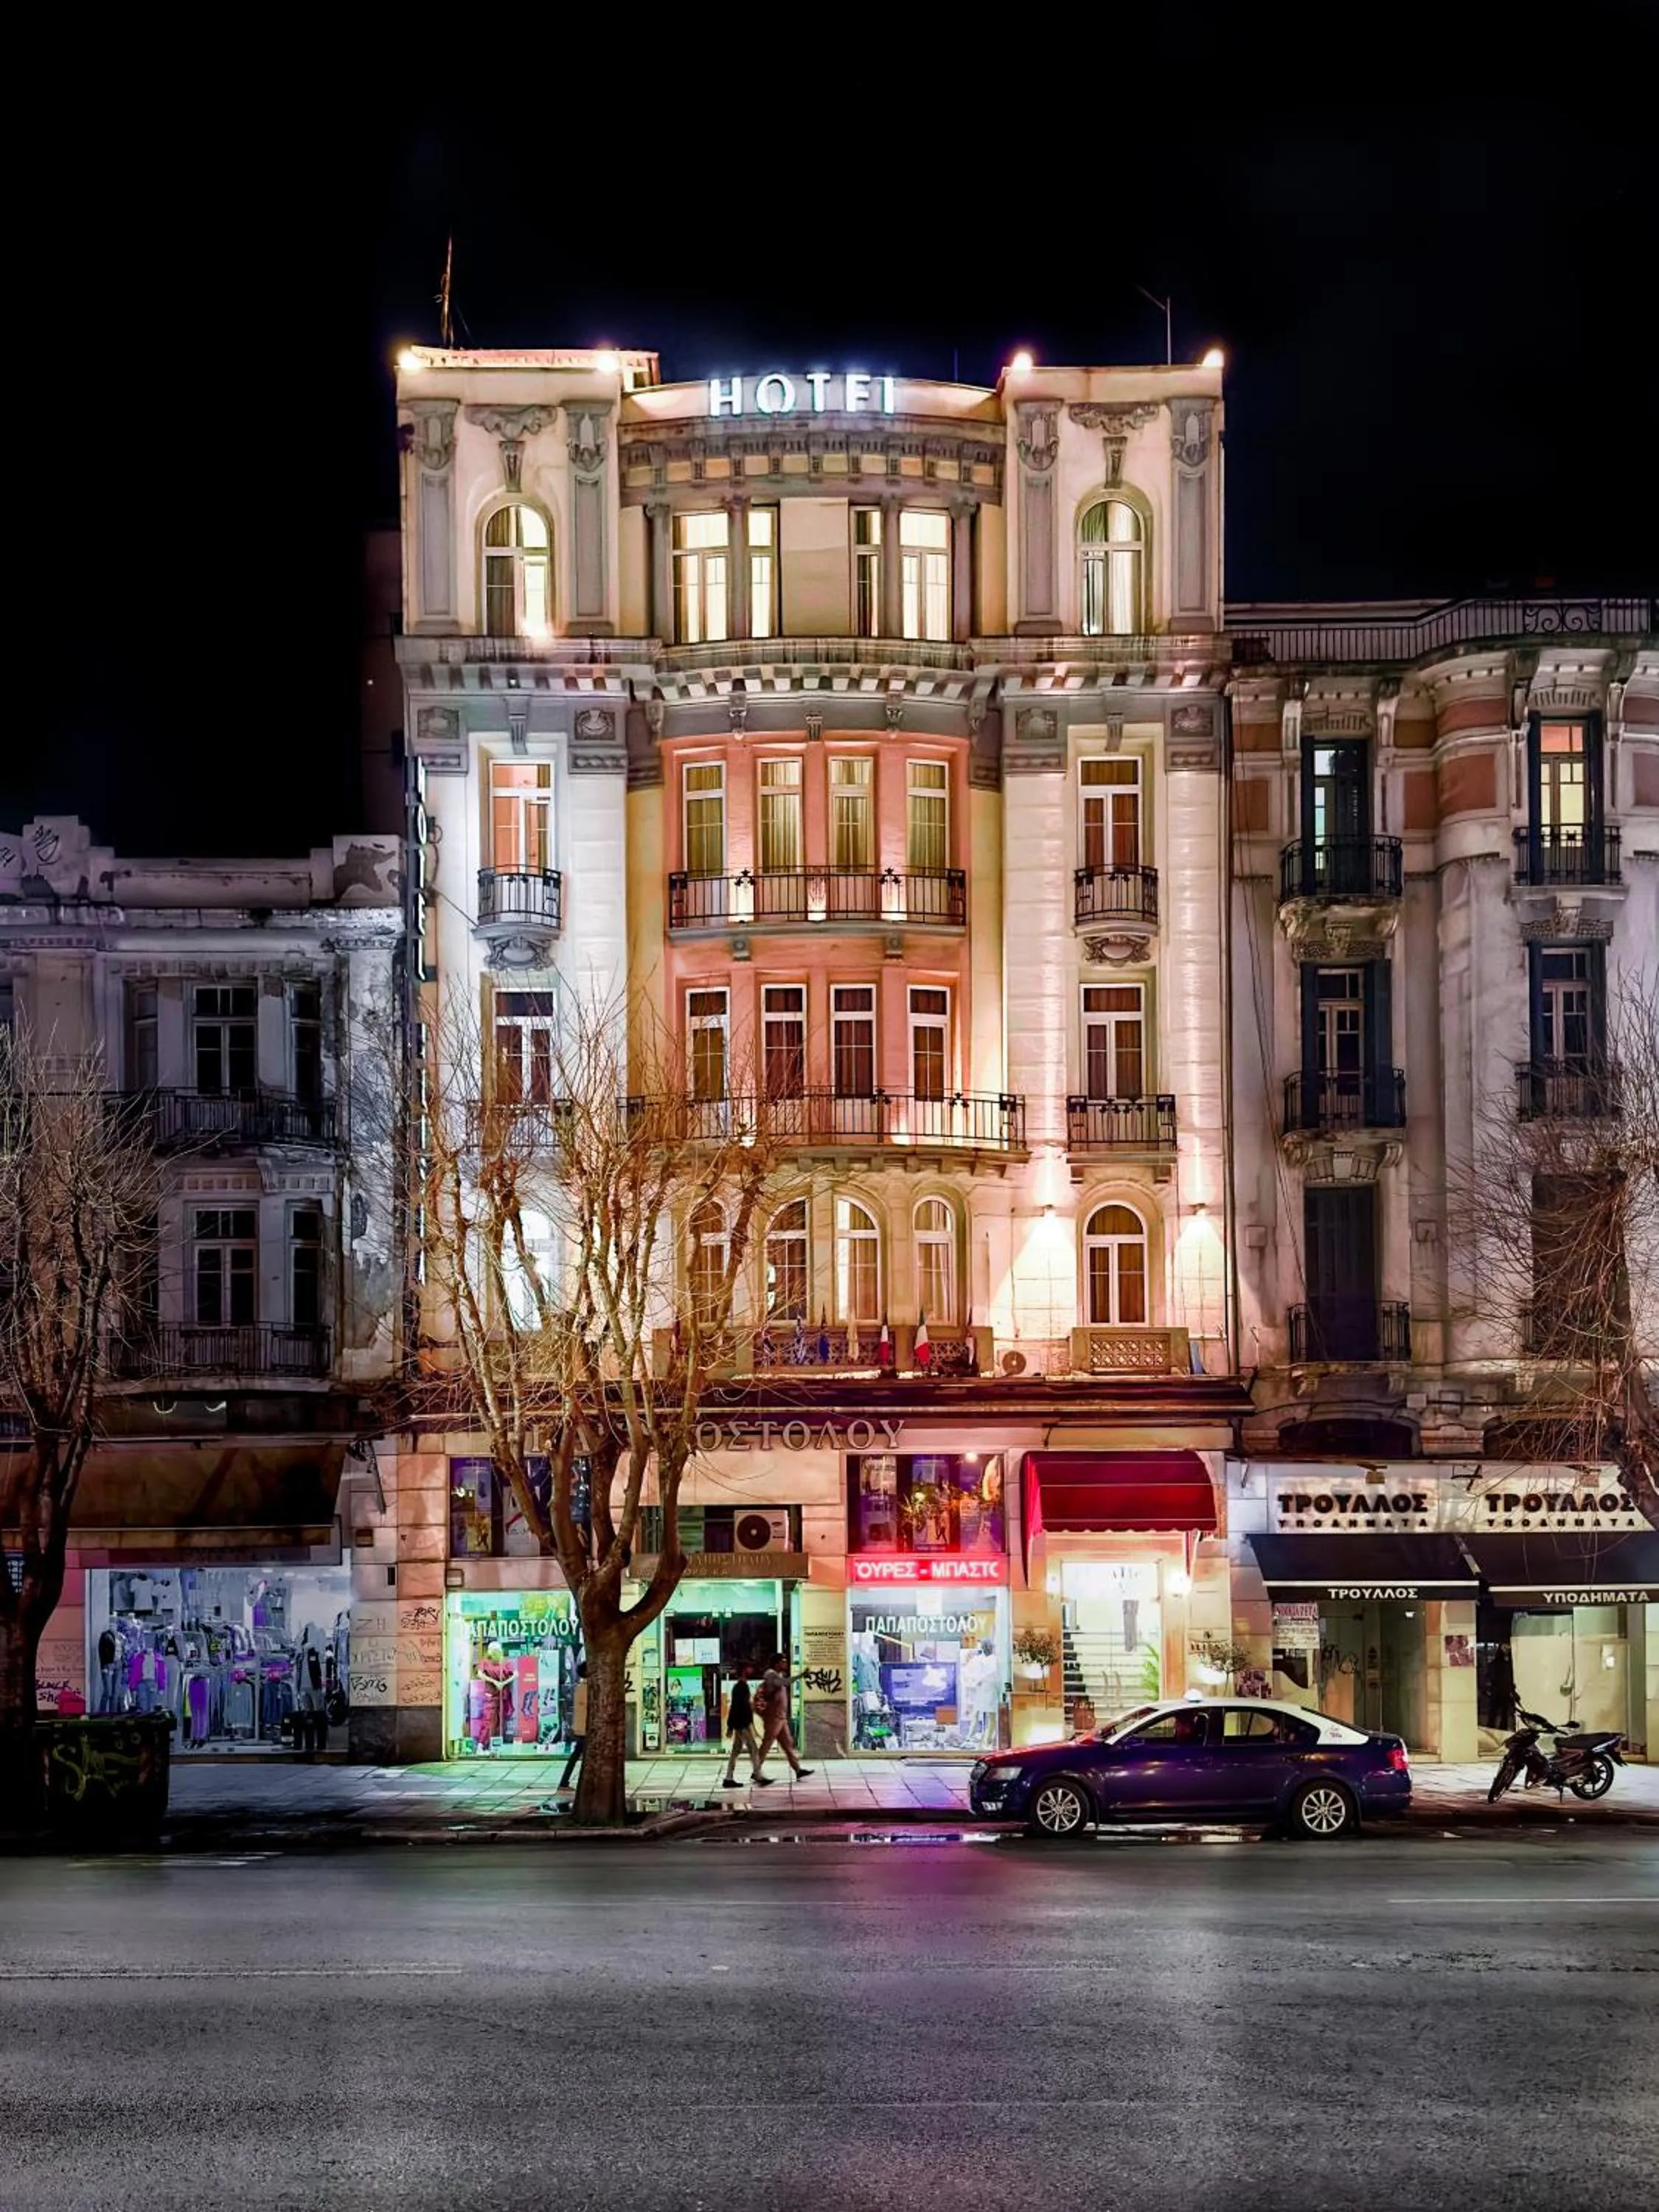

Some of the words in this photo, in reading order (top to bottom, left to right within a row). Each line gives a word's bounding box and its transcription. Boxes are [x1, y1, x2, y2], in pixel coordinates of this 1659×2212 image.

[1277, 1494, 1428, 1513] ΤΡΟΥΛΛΟΣ
[1485, 1493, 1635, 1512] ΤΡΟΥΛΛΟΣ
[1278, 1519, 1428, 1528] ΥΠΟΔΗΜΑΤΑ
[1486, 1518, 1635, 1527] ΥΠΟΔΗΜΑΤΑ
[855, 1562, 917, 1579] ΟΥΡΕΣ
[1327, 1587, 1419, 1599] ΤΡΟΥΛΛΟΣ
[1543, 1590, 1649, 1604] ΥΠΟΔΗΜΑΤΑ
[866, 1616, 987, 1633] ΠΑΠΑΠΟΣΤΟΛΟΥ
